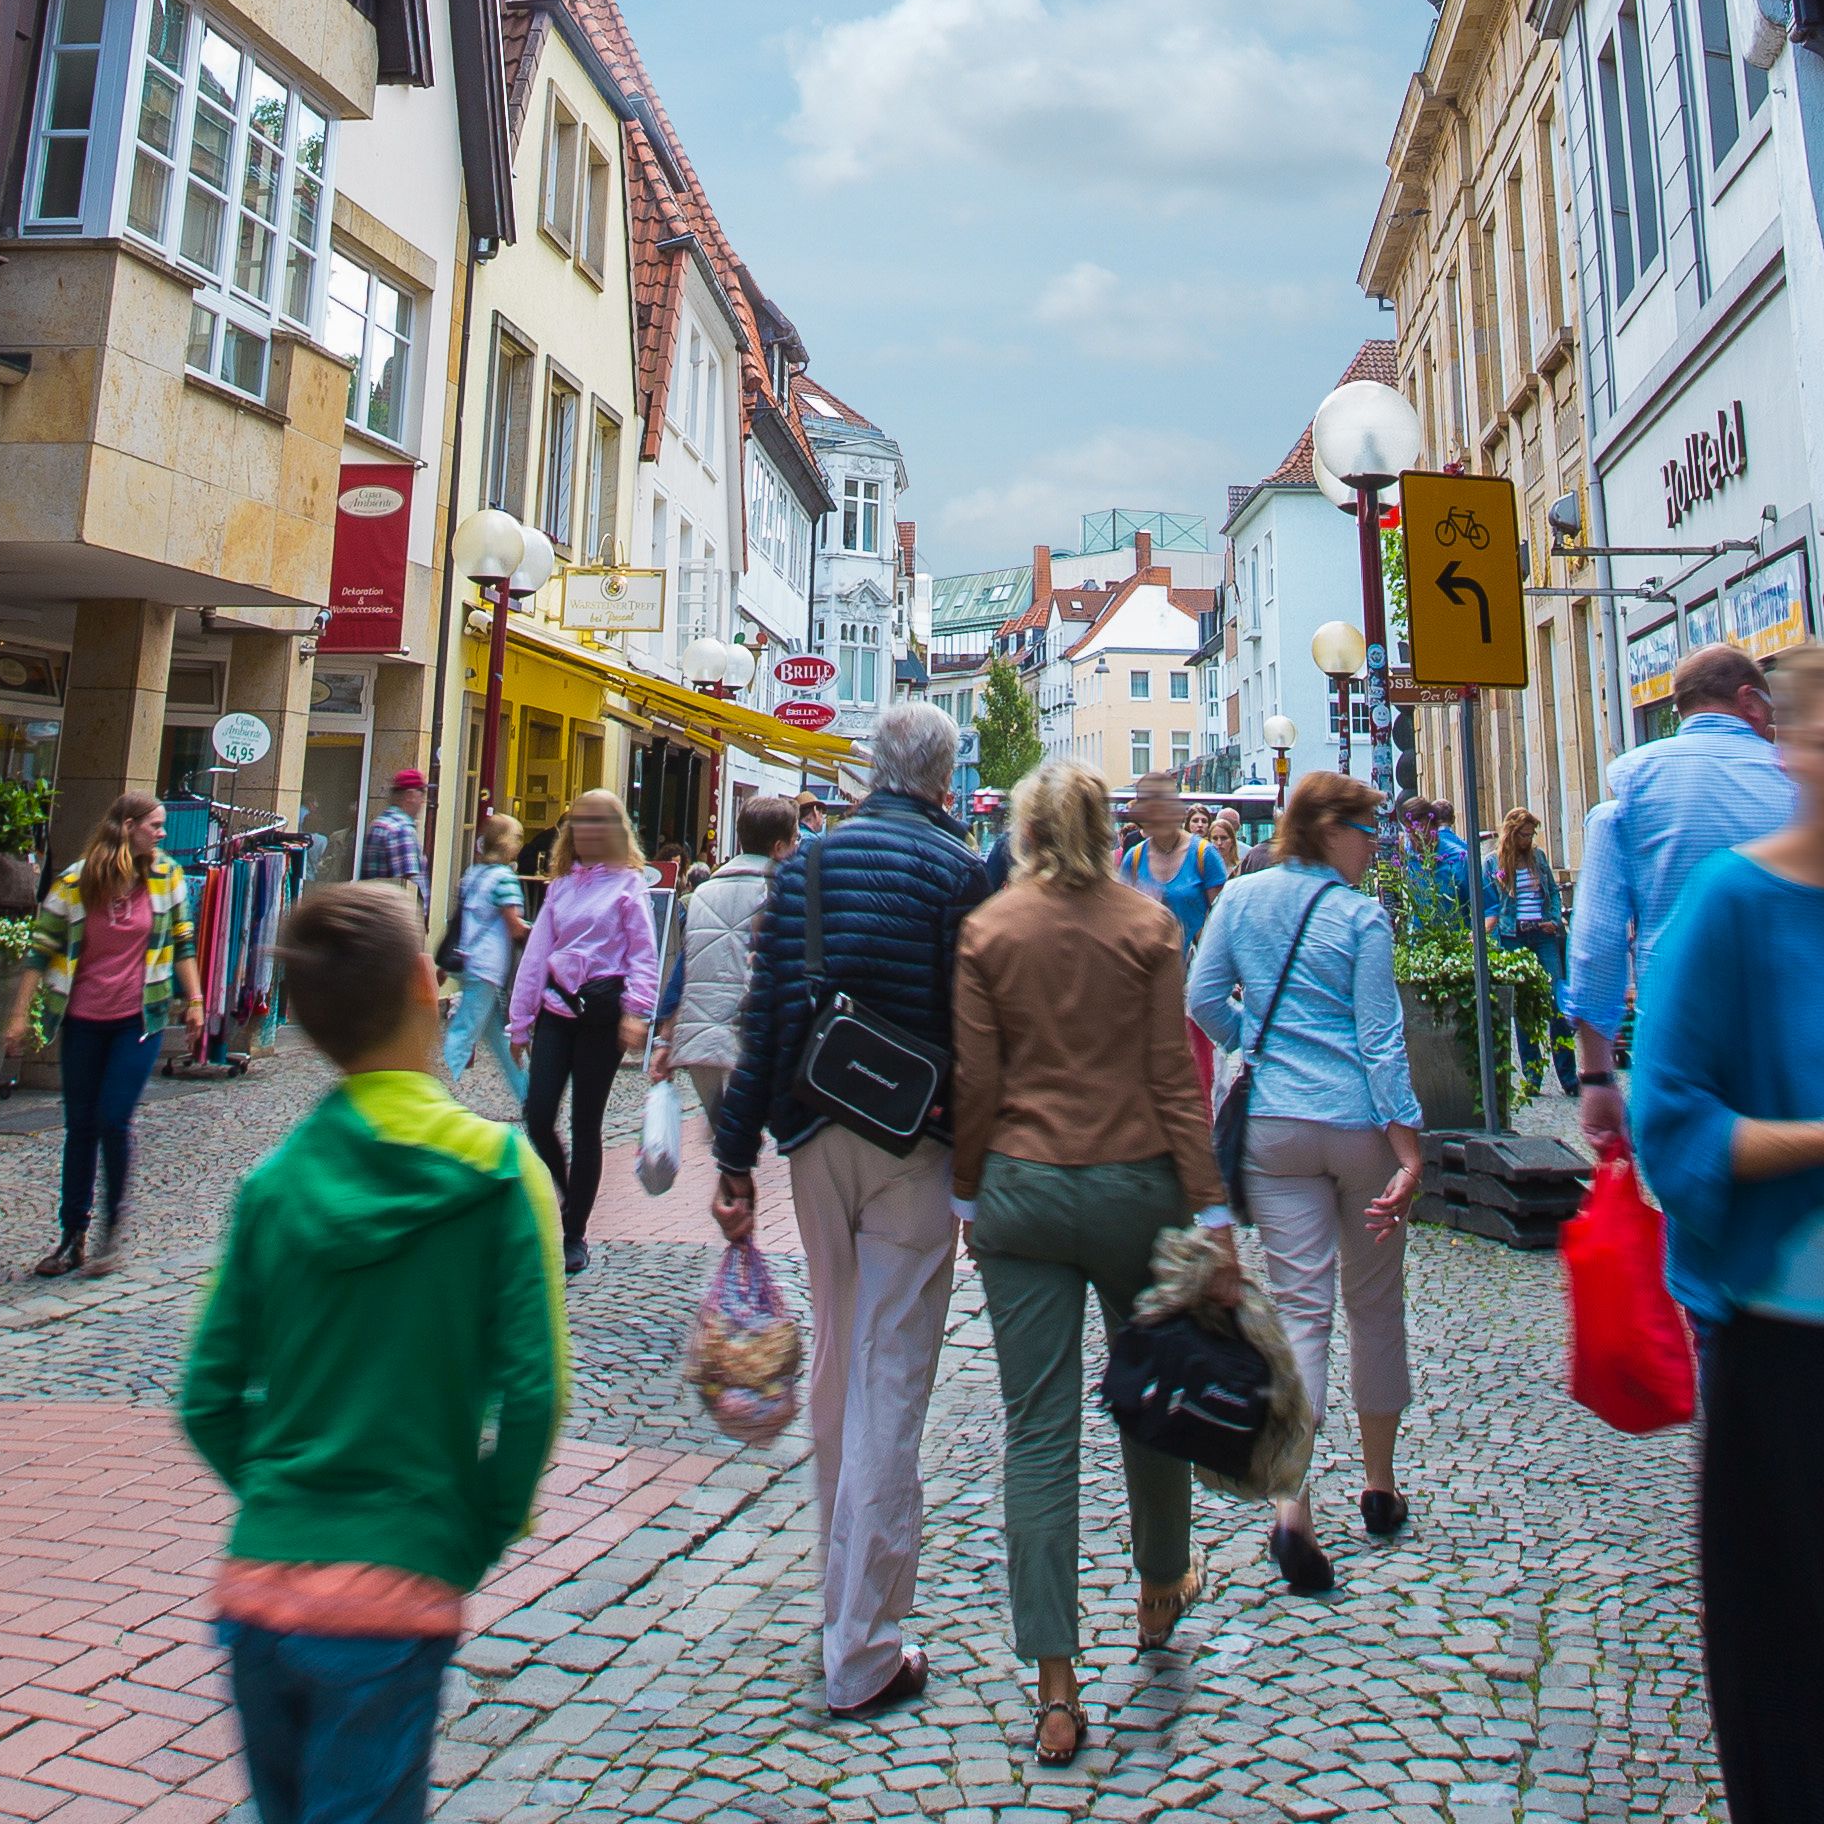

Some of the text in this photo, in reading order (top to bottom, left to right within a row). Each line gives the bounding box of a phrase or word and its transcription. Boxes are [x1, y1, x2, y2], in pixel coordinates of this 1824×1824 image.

[1660, 400, 1747, 529] Hollfeld
[341, 587, 384, 596] Dekoration
[780, 663, 832, 681] BRILLE
